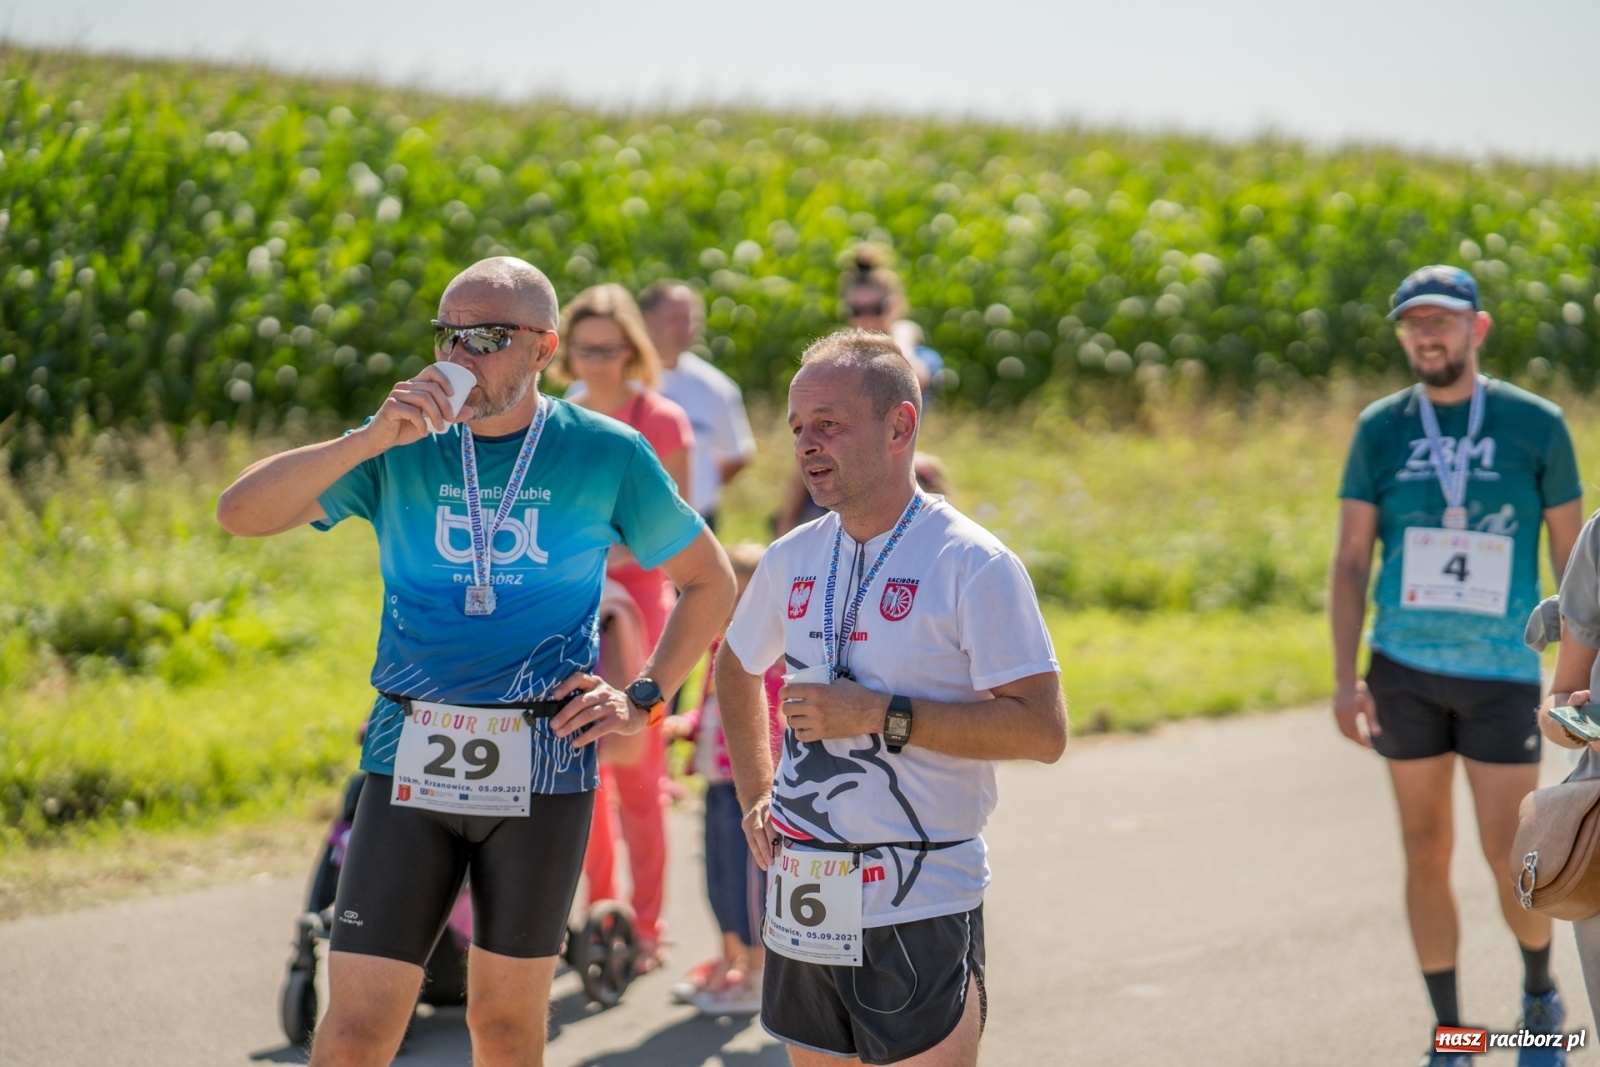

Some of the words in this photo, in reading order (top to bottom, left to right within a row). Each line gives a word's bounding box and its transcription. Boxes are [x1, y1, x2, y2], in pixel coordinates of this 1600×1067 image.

[439, 484, 551, 501] BiegmBubię
[467, 486, 480, 508] RUN
[471, 512, 485, 551] COLOUR
[453, 572, 524, 585] RABÓRZ
[1442, 552, 1471, 582] 4
[824, 575, 837, 615] COLOUR
[823, 618, 834, 641] RUN
[413, 709, 478, 734] COLOUR
[487, 716, 522, 735] RUN
[423, 734, 500, 780] 29
[398, 775, 421, 785] 10km,
[424, 779, 473, 792] Krzanowice,
[478, 785, 526, 793] 05.09.2021
[810, 859, 852, 879] RUN
[775, 873, 827, 927] 16
[806, 931, 858, 941] 05.09.2021
